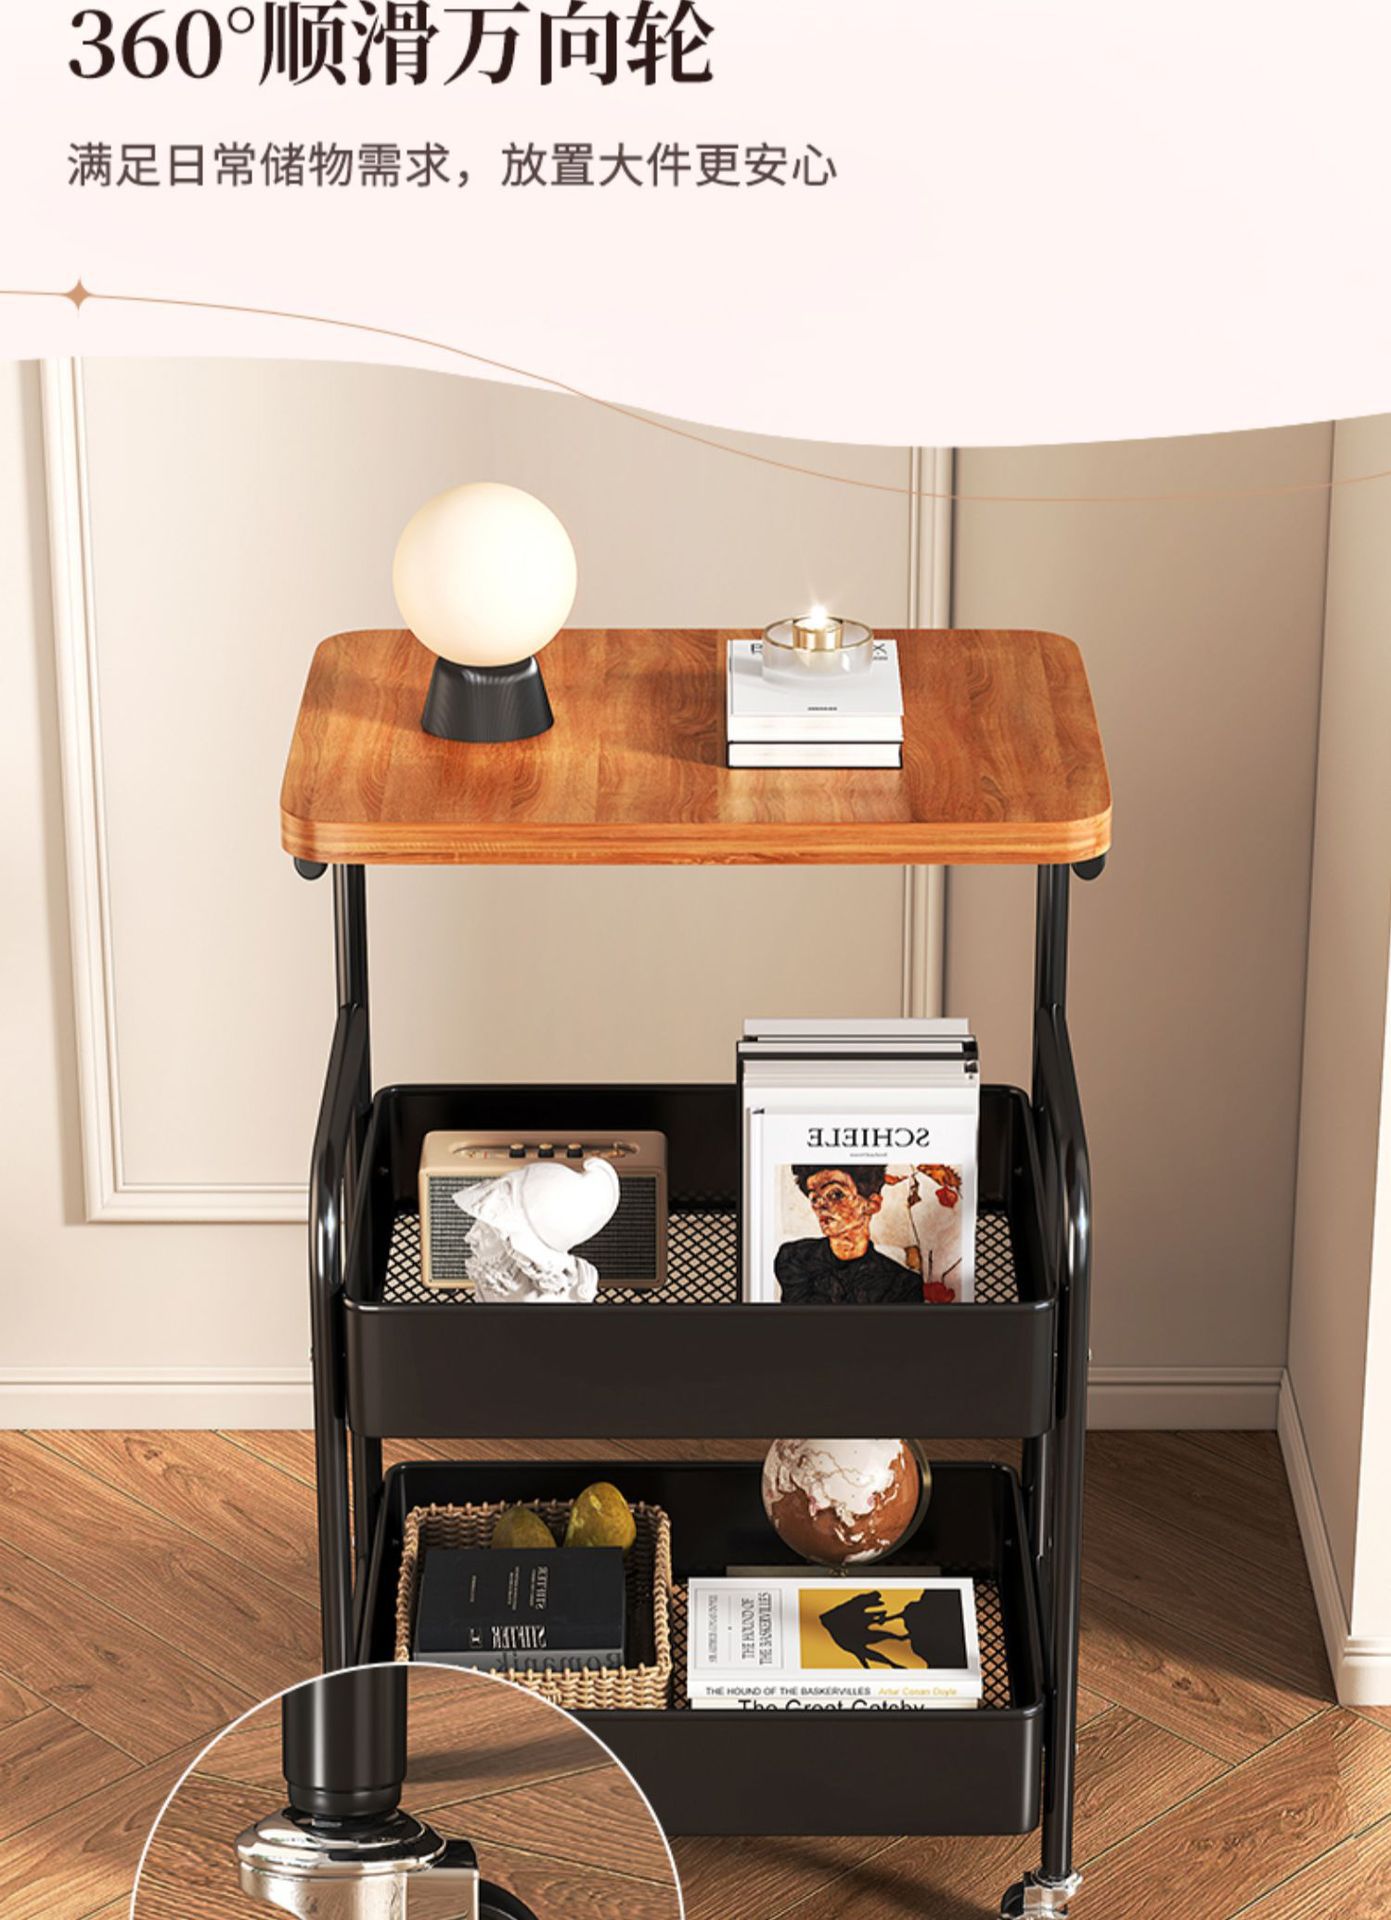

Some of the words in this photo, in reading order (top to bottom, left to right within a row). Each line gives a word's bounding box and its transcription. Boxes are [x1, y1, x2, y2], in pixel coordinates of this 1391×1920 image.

[706, 1686, 724, 1696] THE
[726, 1686, 761, 1696] HOUND
[763, 1686, 777, 1696] OF
[780, 1686, 798, 1696] THE
[800, 1686, 871, 1696] BASKERVILLES
